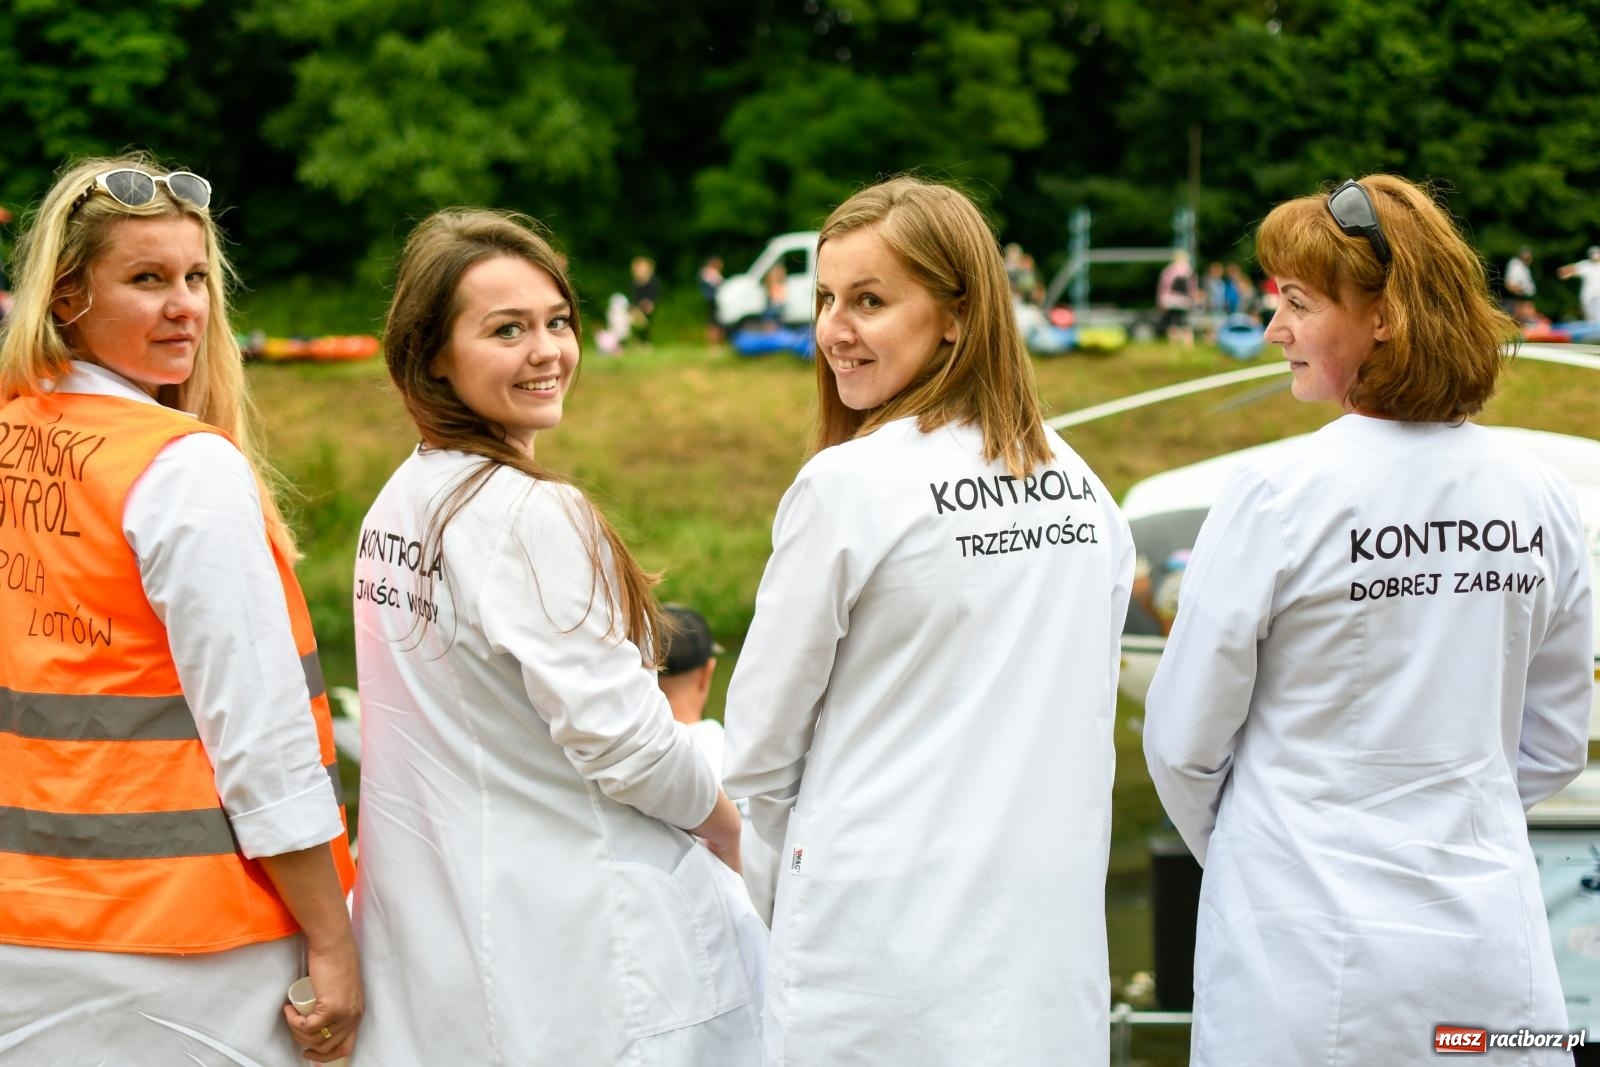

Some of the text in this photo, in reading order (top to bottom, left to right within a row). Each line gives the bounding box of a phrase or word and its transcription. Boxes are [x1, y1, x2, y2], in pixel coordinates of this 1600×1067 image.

[930, 470, 1097, 514] KONTROLA
[359, 528, 443, 581] KONTROLA
[956, 515, 1098, 557] TRZEŹWOŚCI
[1350, 519, 1544, 563] KONTROLA
[1350, 573, 1442, 601] DOBREJ
[28, 604, 111, 647] LOTÓW
